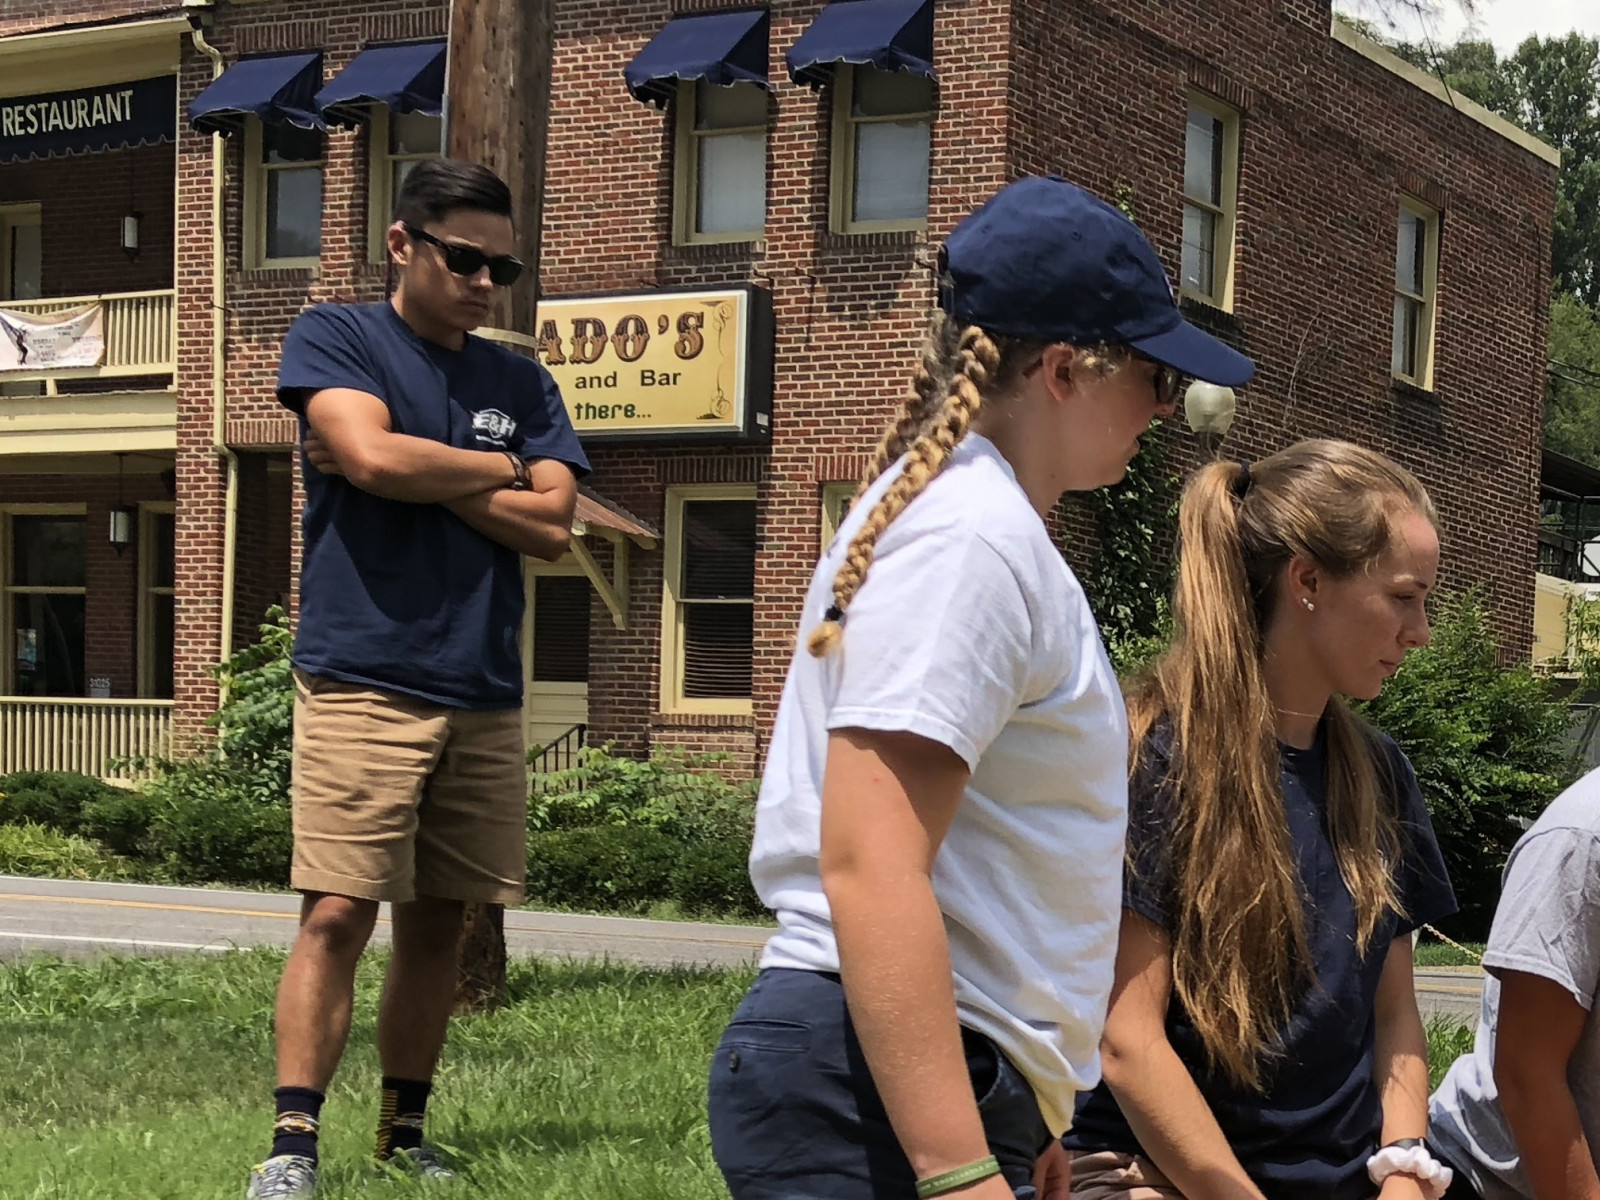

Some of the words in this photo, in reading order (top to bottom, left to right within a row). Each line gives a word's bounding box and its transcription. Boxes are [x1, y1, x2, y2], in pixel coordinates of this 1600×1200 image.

[2, 89, 134, 137] RESTAURANT
[575, 371, 617, 389] and
[640, 369, 681, 387] Bar
[574, 402, 652, 420] there...
[472, 412, 517, 438] E&H
